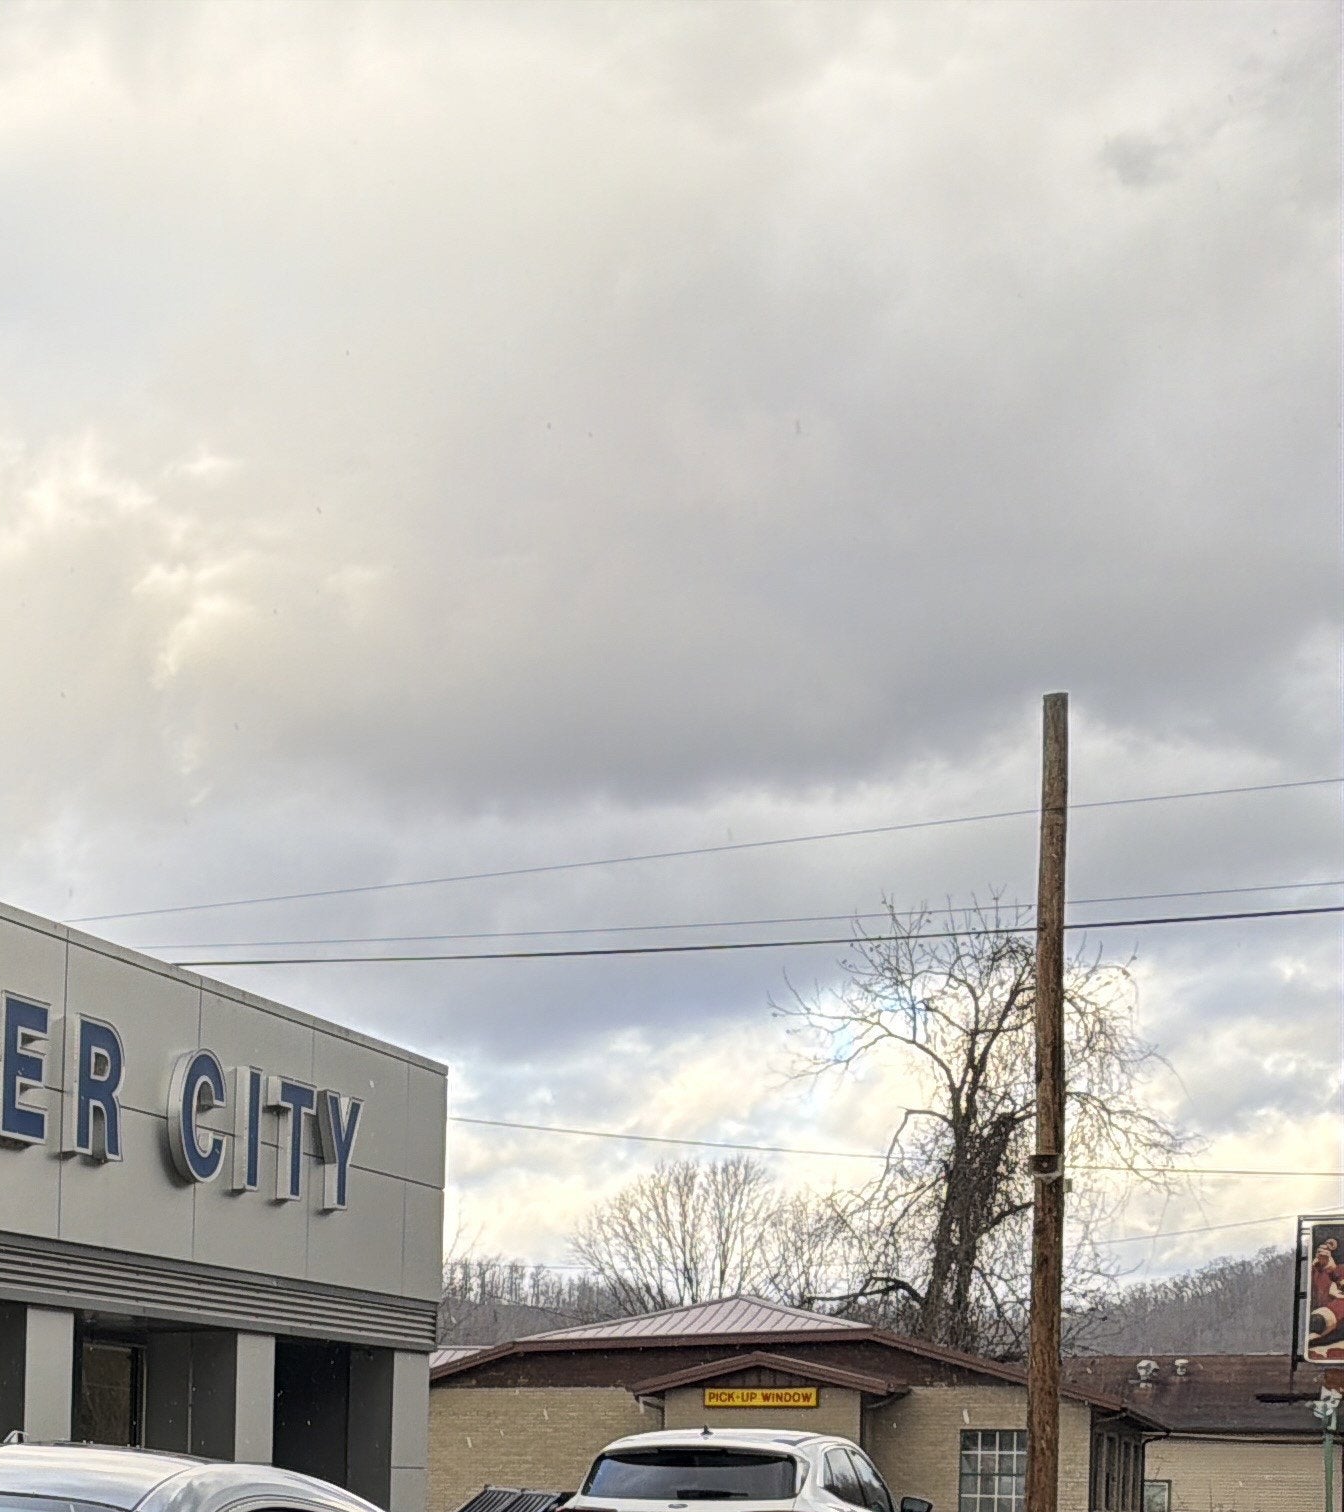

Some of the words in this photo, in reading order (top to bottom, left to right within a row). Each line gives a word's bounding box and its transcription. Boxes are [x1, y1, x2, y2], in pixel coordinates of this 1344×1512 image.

[167, 1047, 365, 1212] CITY
[708, 1391, 758, 1403] PICK-UP
[761, 1392, 813, 1403] WINDOW
